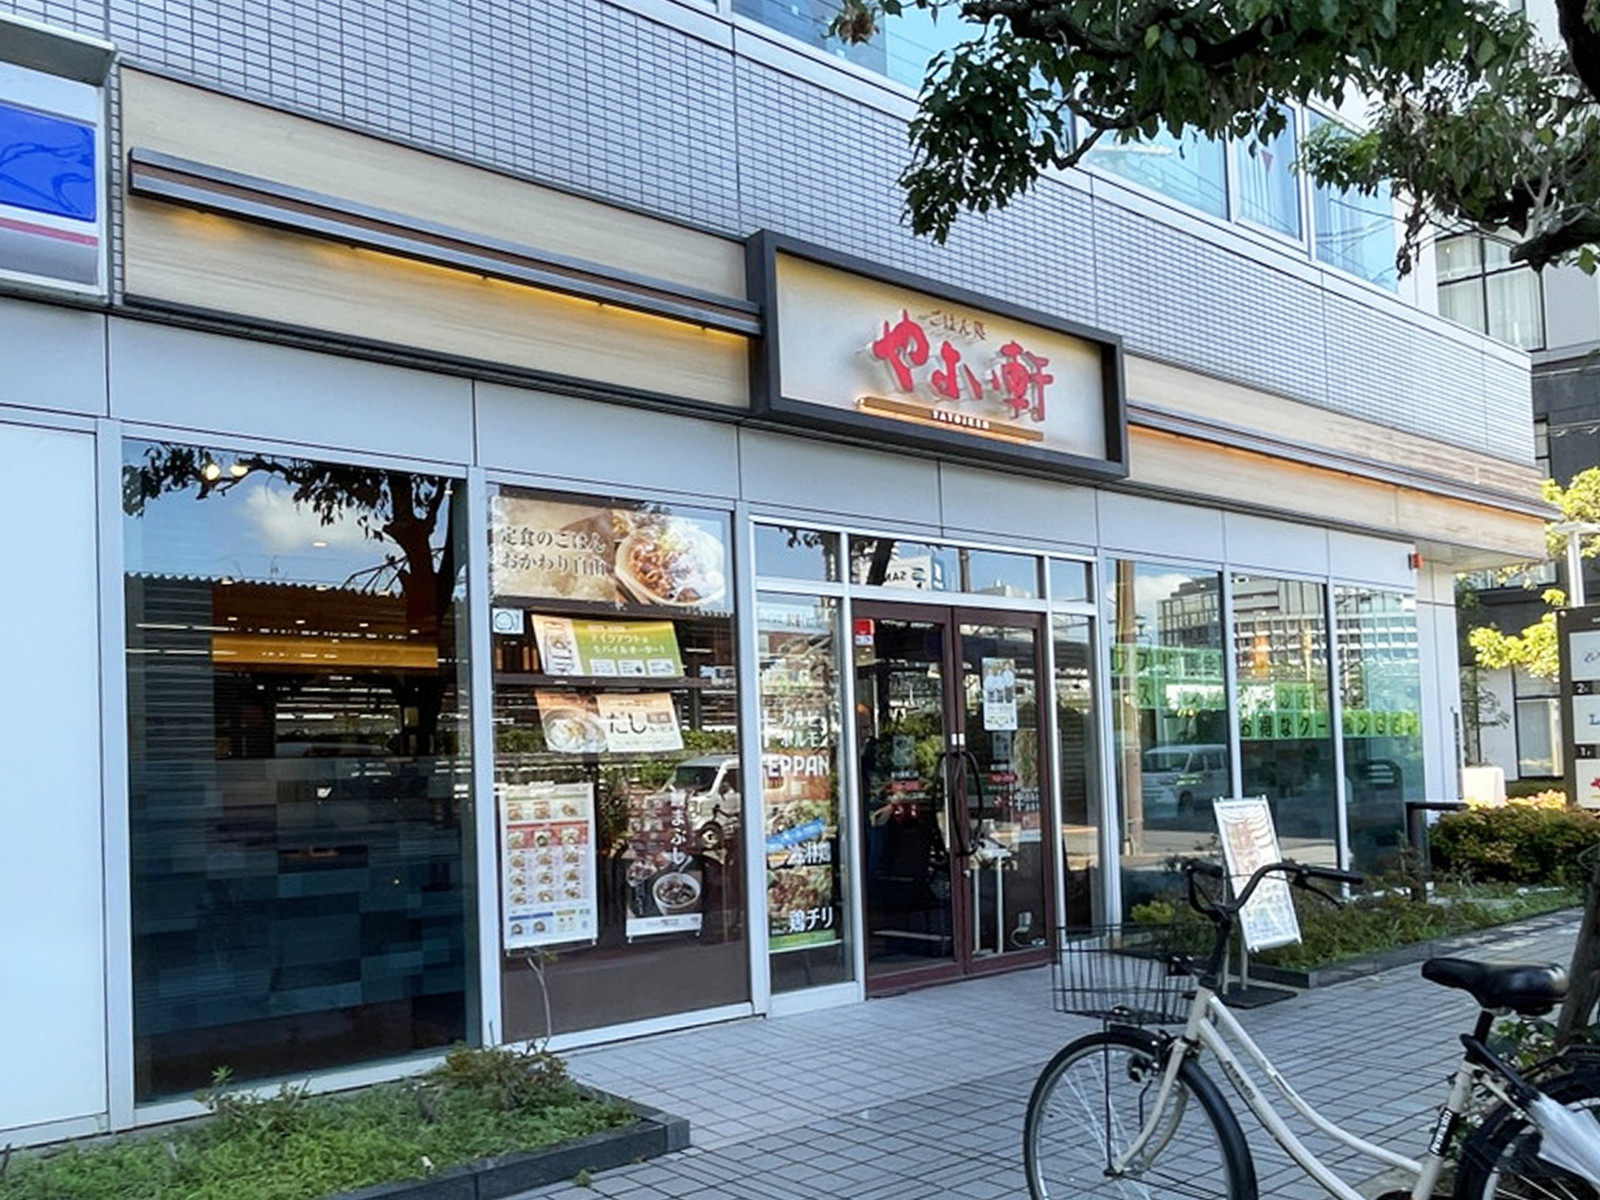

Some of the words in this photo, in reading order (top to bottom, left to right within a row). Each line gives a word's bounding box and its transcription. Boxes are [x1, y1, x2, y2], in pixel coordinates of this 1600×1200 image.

[873, 308, 1054, 422] やよい軒
[501, 525, 606, 554] 定食のごはん
[501, 551, 606, 577] おかわり自由
[789, 907, 833, 933] 鶏チリ
